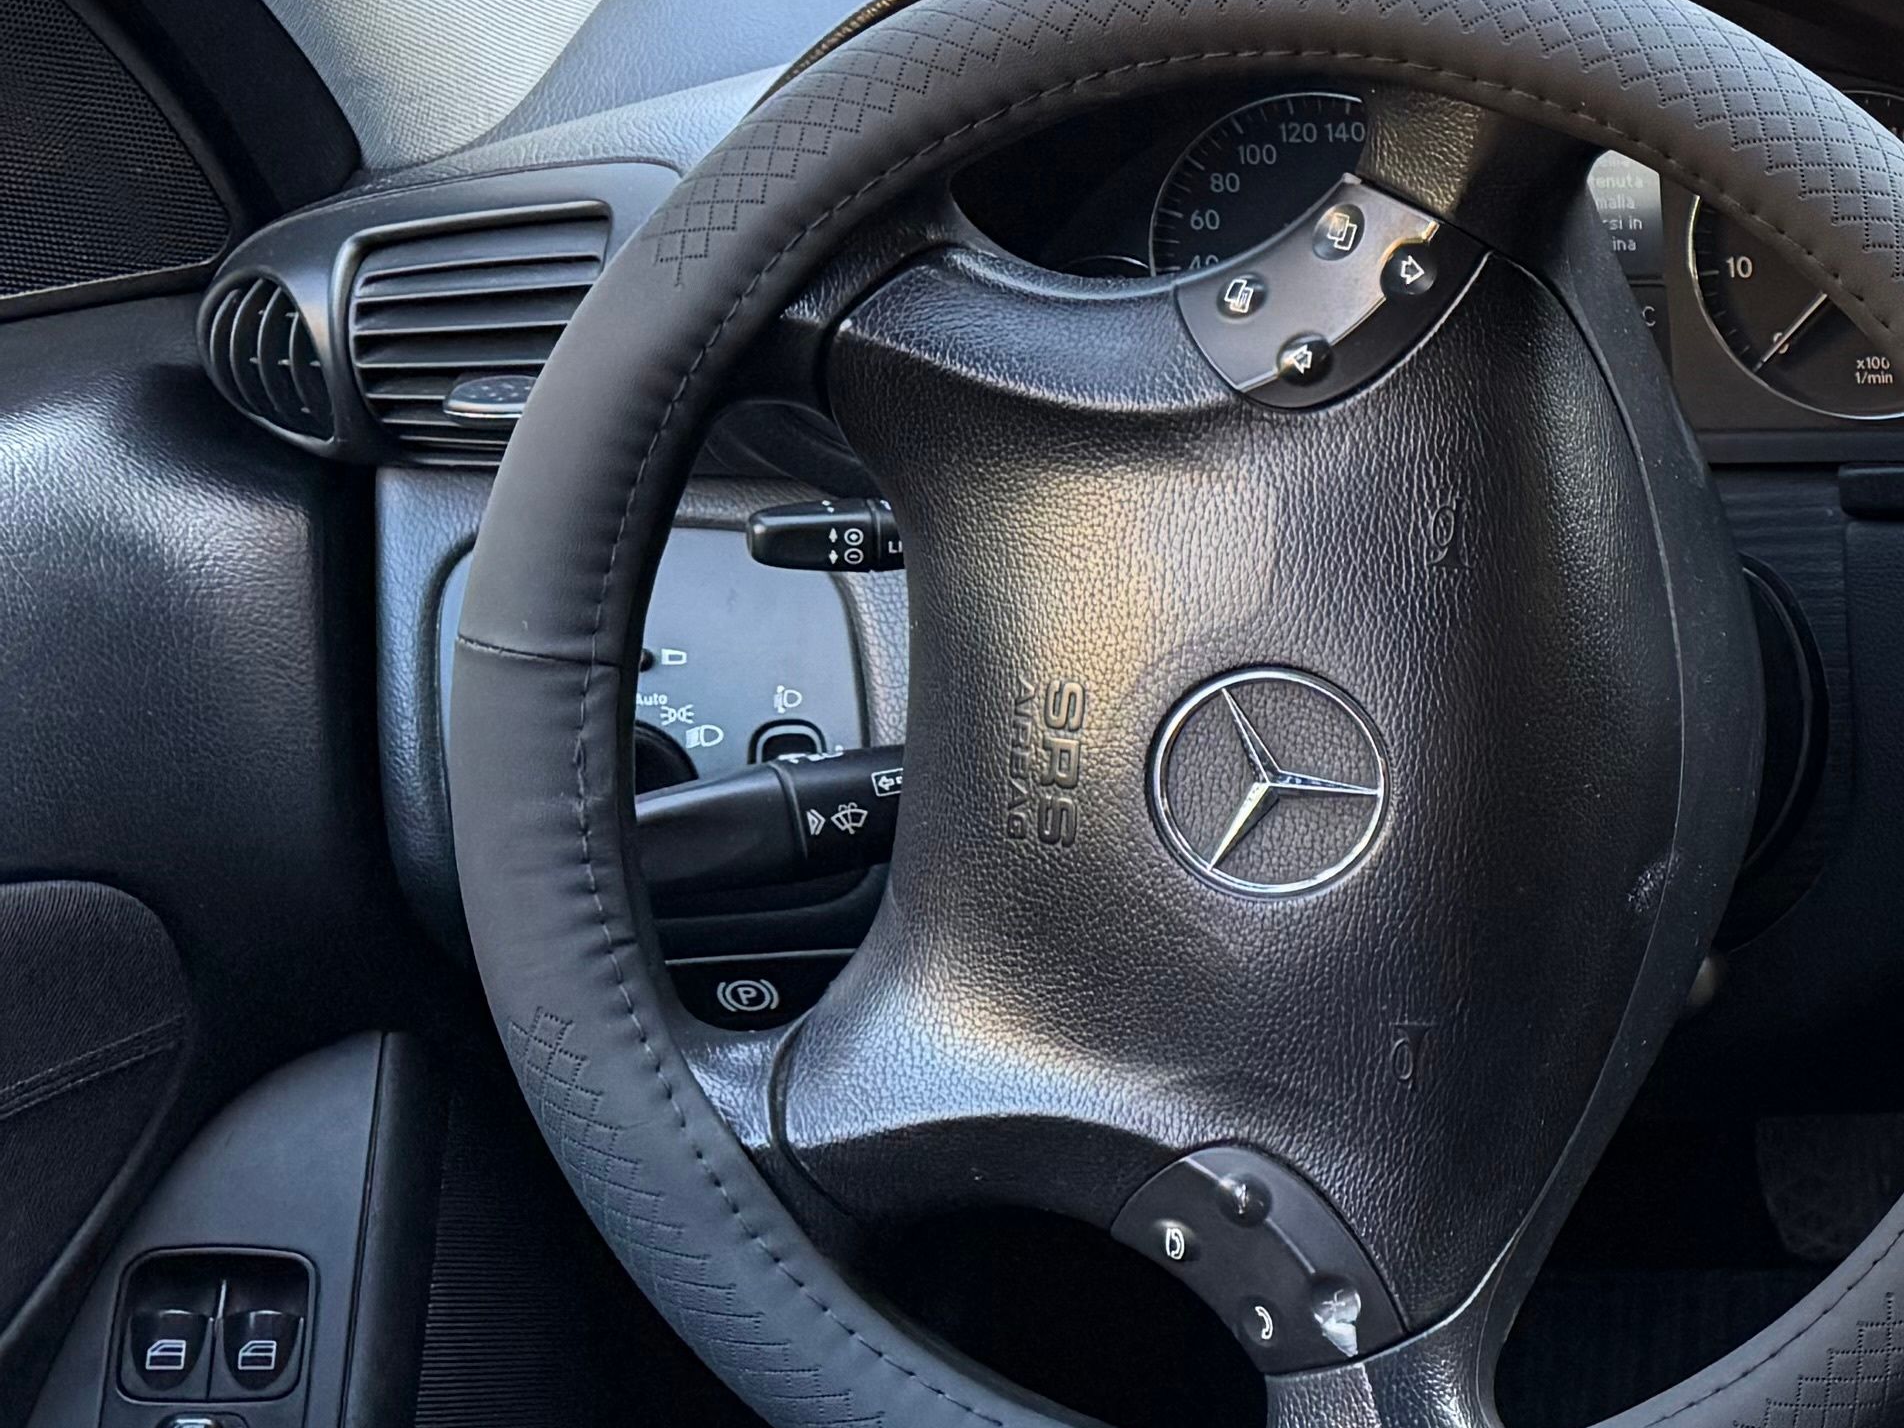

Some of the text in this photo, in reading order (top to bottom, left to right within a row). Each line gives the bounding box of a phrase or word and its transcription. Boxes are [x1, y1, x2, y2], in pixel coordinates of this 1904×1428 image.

[1279, 122, 1366, 143] 120 140
[1237, 144, 1277, 165] 100
[1209, 172, 1240, 193] 80
[1190, 209, 1220, 230] 60
[1725, 256, 1753, 279] 10
[1856, 356, 1890, 371] x100
[1855, 372, 1893, 386] 1/min
[1037, 679, 1086, 848] SRS
